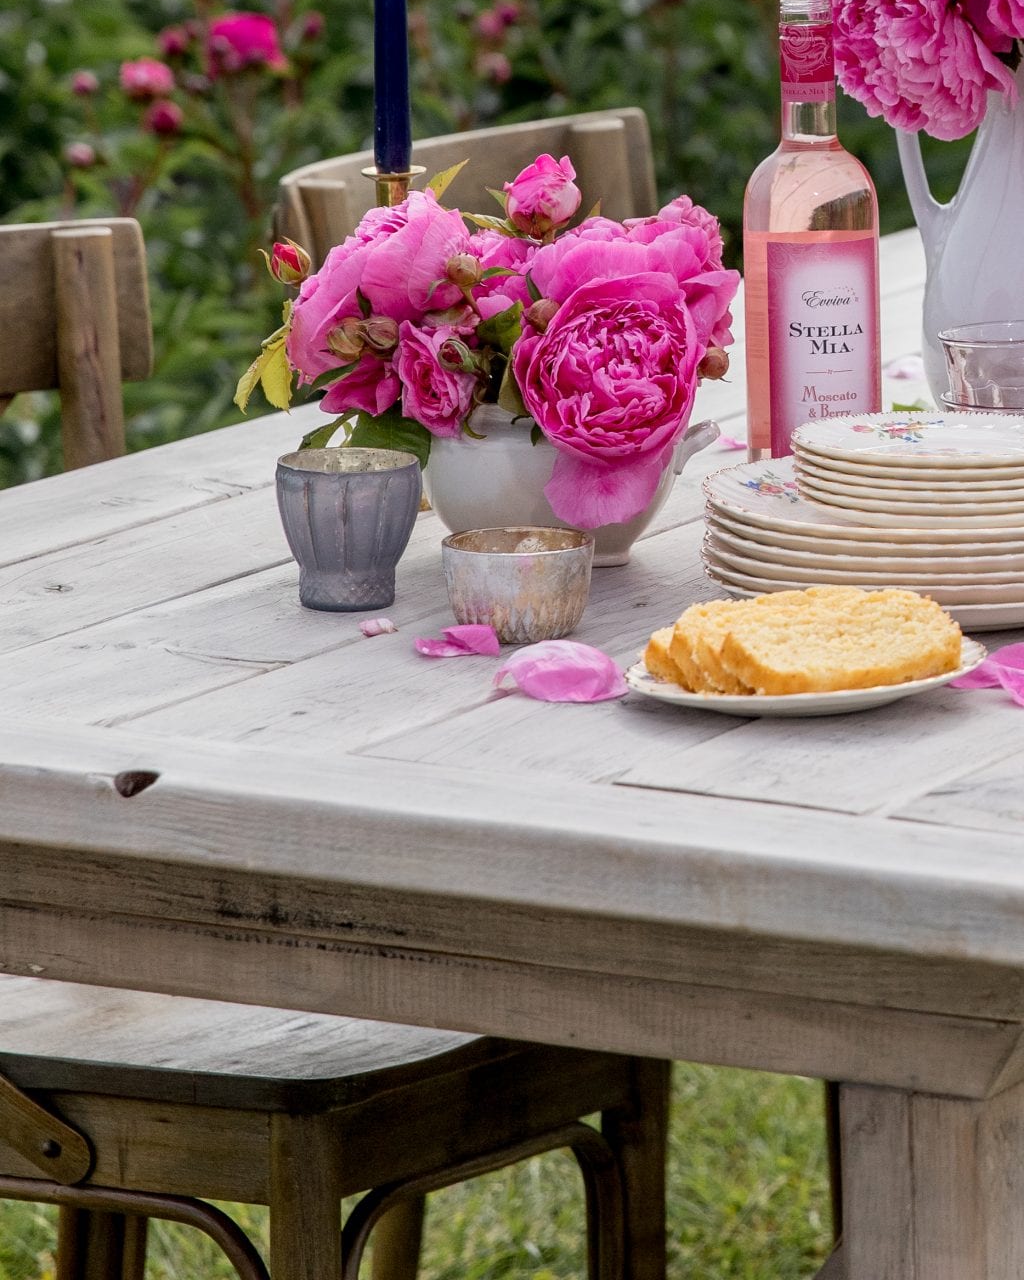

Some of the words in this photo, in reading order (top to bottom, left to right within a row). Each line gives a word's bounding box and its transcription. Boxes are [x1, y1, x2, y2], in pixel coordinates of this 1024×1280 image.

[801, 290, 851, 308] Evviva
[789, 322, 864, 338] STELLA
[801, 385, 858, 402] Moscato
[808, 407, 817, 418] &
[820, 403, 852, 418] Berry
